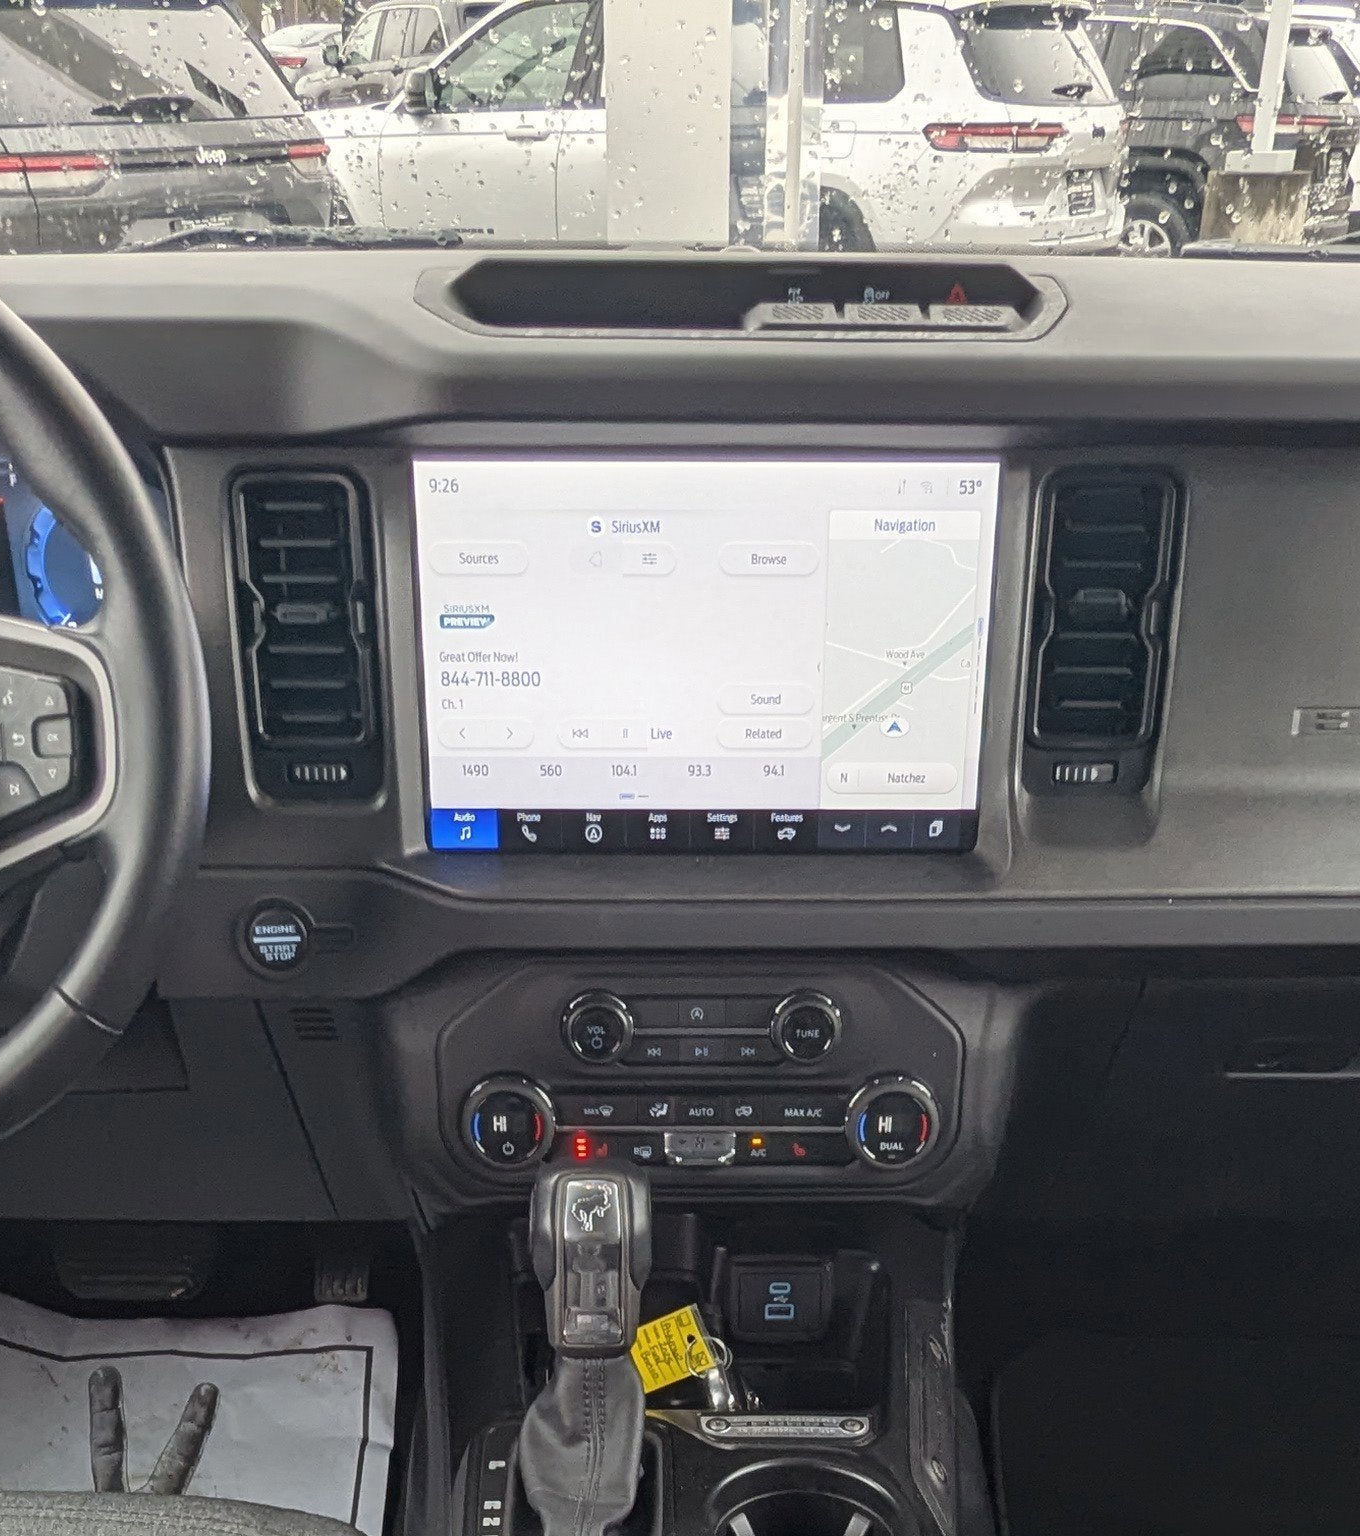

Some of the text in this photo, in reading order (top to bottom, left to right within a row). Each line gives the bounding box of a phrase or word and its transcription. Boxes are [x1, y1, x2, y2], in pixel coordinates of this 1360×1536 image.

[196, 145, 228, 167] Jeep
[429, 478, 459, 494] 9:26
[959, 479, 983, 495] 53°
[611, 520, 661, 534] SiriusXM
[873, 518, 937, 534] Navigation
[458, 552, 499, 565] Sources
[750, 553, 787, 566] Browse
[443, 617, 490, 627] PREVIEW
[439, 651, 518, 663] Great Offer Now!
[886, 649, 926, 660] Wood Ave
[440, 670, 541, 687] 844-711-8800
[441, 699, 457, 710] Ch.
[750, 693, 781, 705] Sound
[650, 727, 673, 740] Live
[745, 728, 782, 740] Related
[461, 763, 489, 777] 1490
[540, 763, 562, 777] 560
[611, 763, 638, 777] 104.1
[687, 763, 712, 777] 93.3
[762, 764, 786, 777] 94.1
[887, 772, 926, 784] Natchez
[453, 812, 476, 822] Audio
[516, 812, 541, 822] Phone
[586, 812, 602, 822] Nav
[648, 812, 667, 823] Apps
[707, 812, 738, 823] Settings
[770, 812, 803, 822] Features
[254, 925, 296, 935] ENGINE
[259, 944, 297, 953] START
[265, 952, 296, 961] STOP
[587, 1025, 606, 1035] VOL
[795, 1029, 820, 1039] TUNE
[688, 1107, 715, 1117] AUTO
[784, 1107, 822, 1117] MAX A/C
[493, 1115, 507, 1132] HI
[878, 1116, 893, 1133] HI
[750, 1148, 767, 1157] A/C
[879, 1142, 904, 1151] DUAL
[482, 1517, 500, 1526] N
